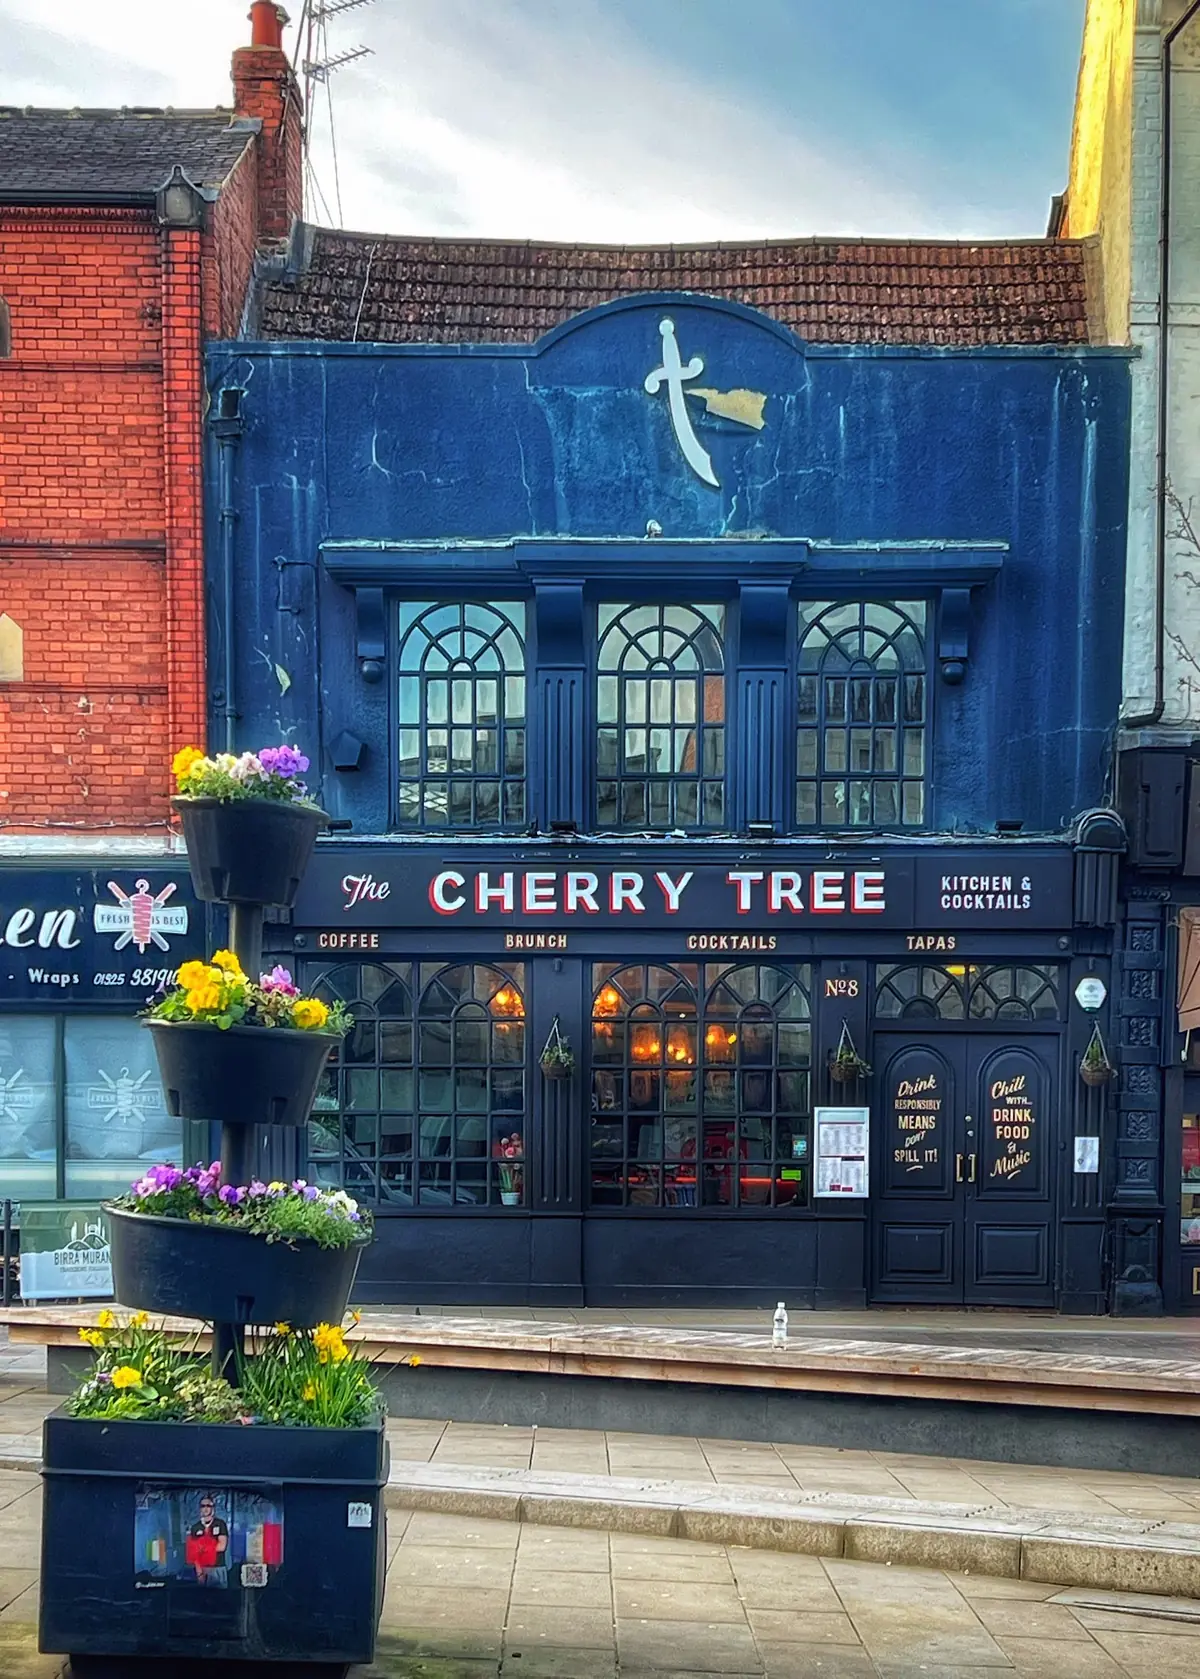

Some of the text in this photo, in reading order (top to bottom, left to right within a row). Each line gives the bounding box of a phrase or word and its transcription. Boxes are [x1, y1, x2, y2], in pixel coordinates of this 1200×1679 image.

[941, 876, 1032, 891] KITCHEN &
[341, 870, 886, 916] The CHERRY TREE
[941, 894, 1031, 910] COCKTAILS
[101, 914, 131, 924] FRESH
[151, 915, 184, 926] IS BEST
[0, 908, 81, 949] en
[319, 933, 379, 948] COFFEE
[505, 933, 568, 949] BRUNCH
[687, 934, 777, 950] COCKTAILS
[906, 935, 956, 950] TAPAS
[28, 967, 80, 987] Wraps
[898, 1074, 937, 1097] Drink
[991, 1076, 1026, 1099] Chill
[894, 1099, 941, 1111] RESPONSIBLY
[898, 1115, 936, 1129] MEANS
[993, 1108, 1035, 1123] DRINK,
[996, 1125, 1030, 1140] FOOD
[894, 1148, 938, 1163] SPILL IT!
[990, 1149, 1031, 1177] Music
[54, 1251, 79, 1266] BIRRA
